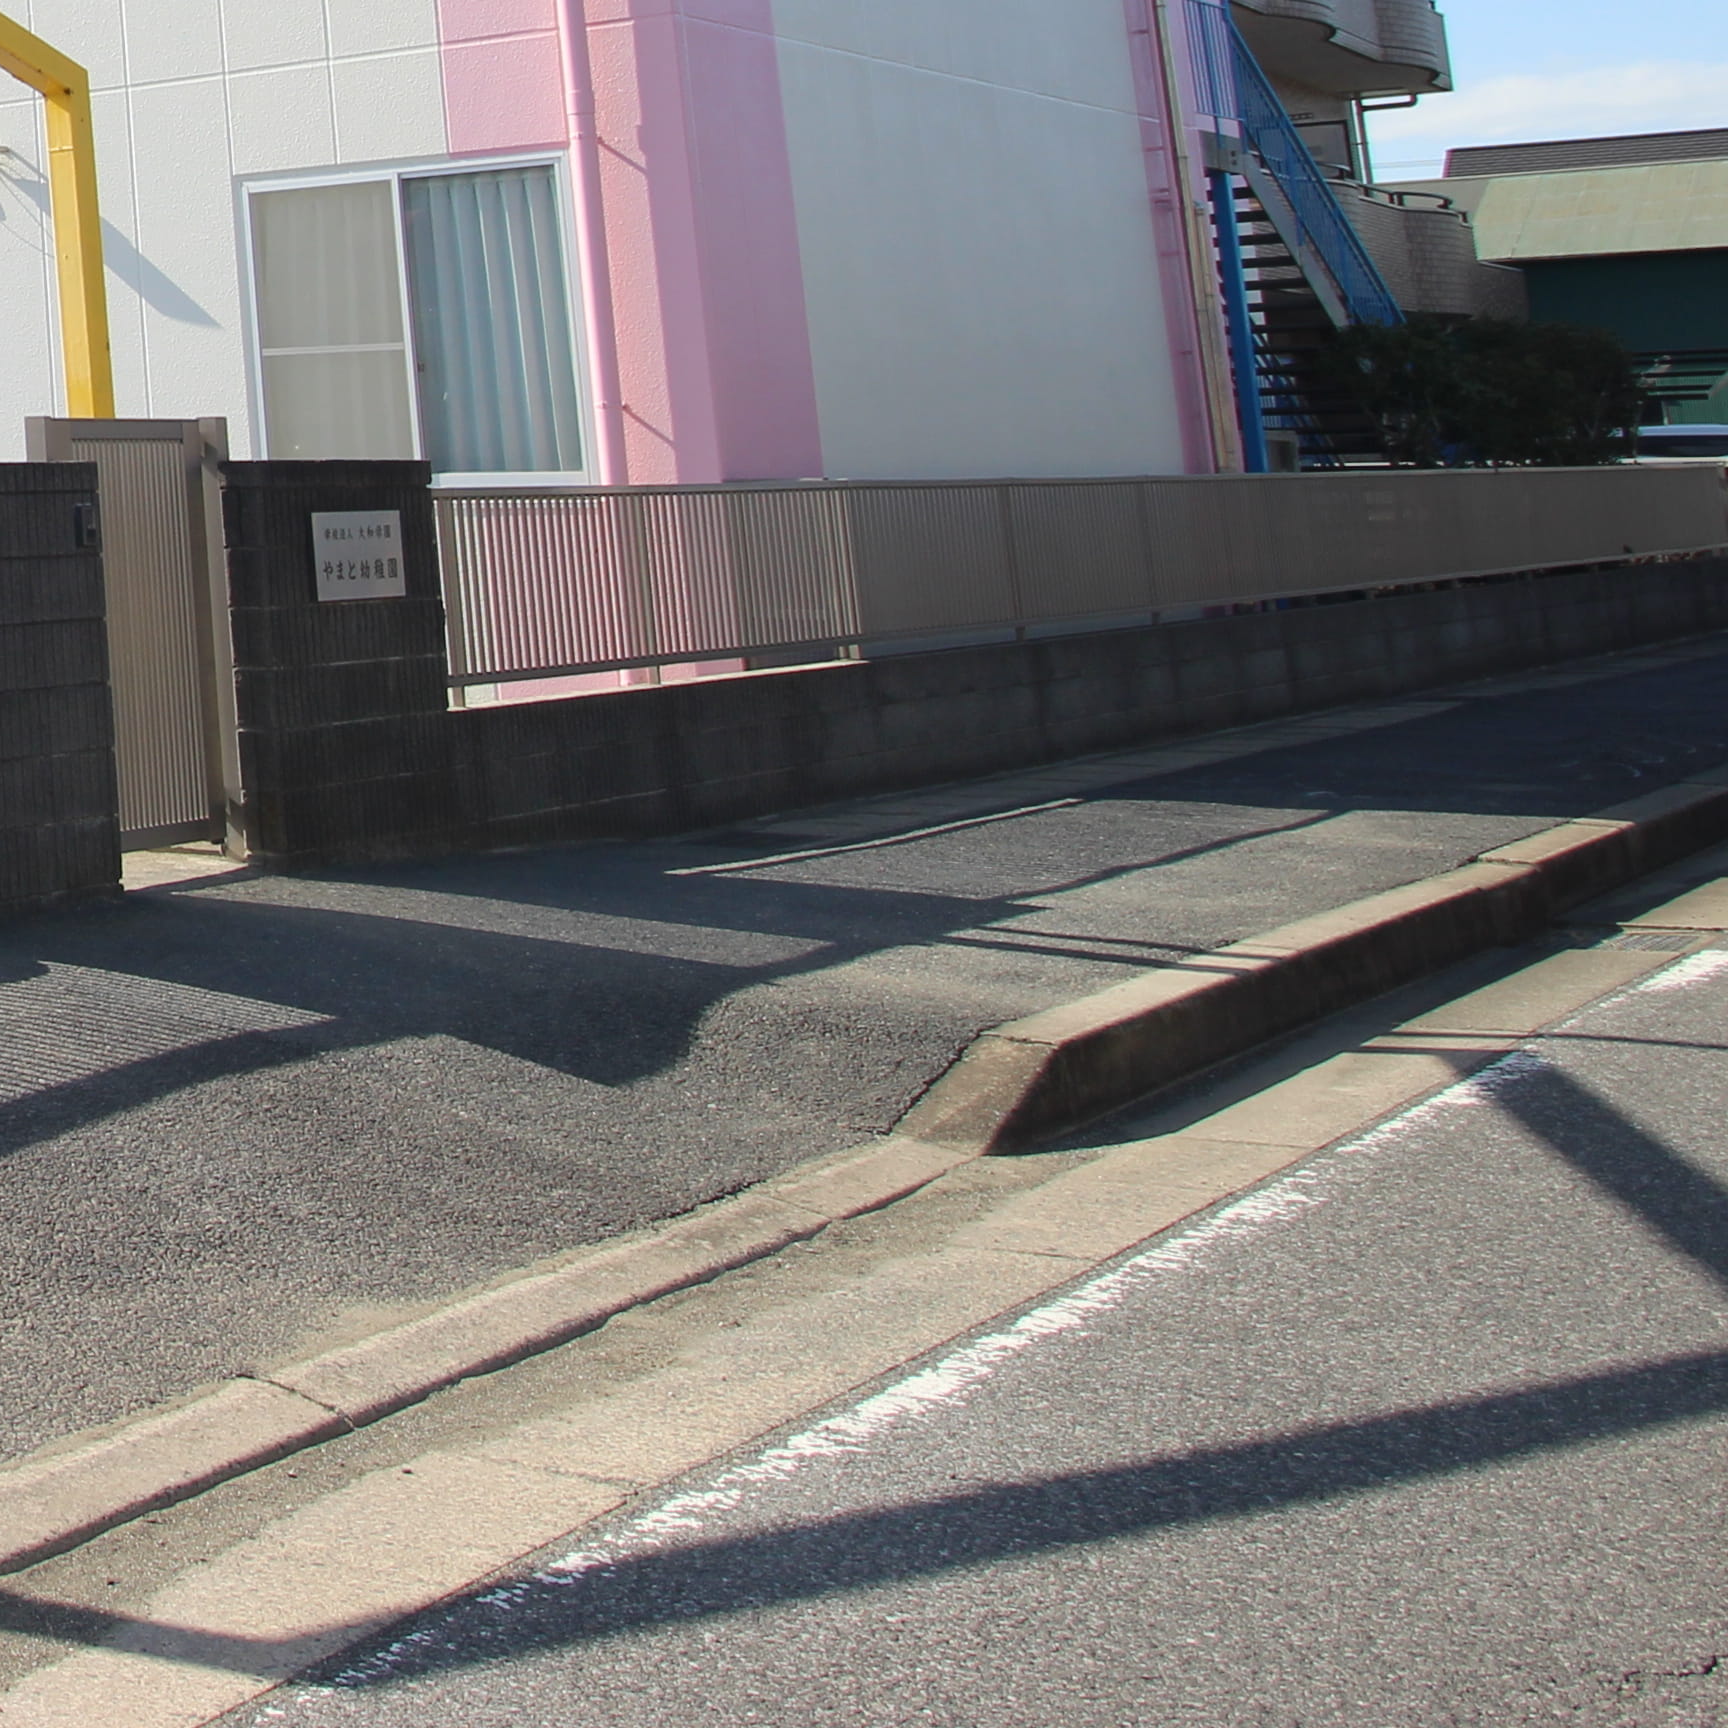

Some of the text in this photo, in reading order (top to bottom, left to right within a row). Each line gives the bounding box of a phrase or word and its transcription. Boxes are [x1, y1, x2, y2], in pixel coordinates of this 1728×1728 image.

[323, 557, 398, 582] やまと幼稚園
